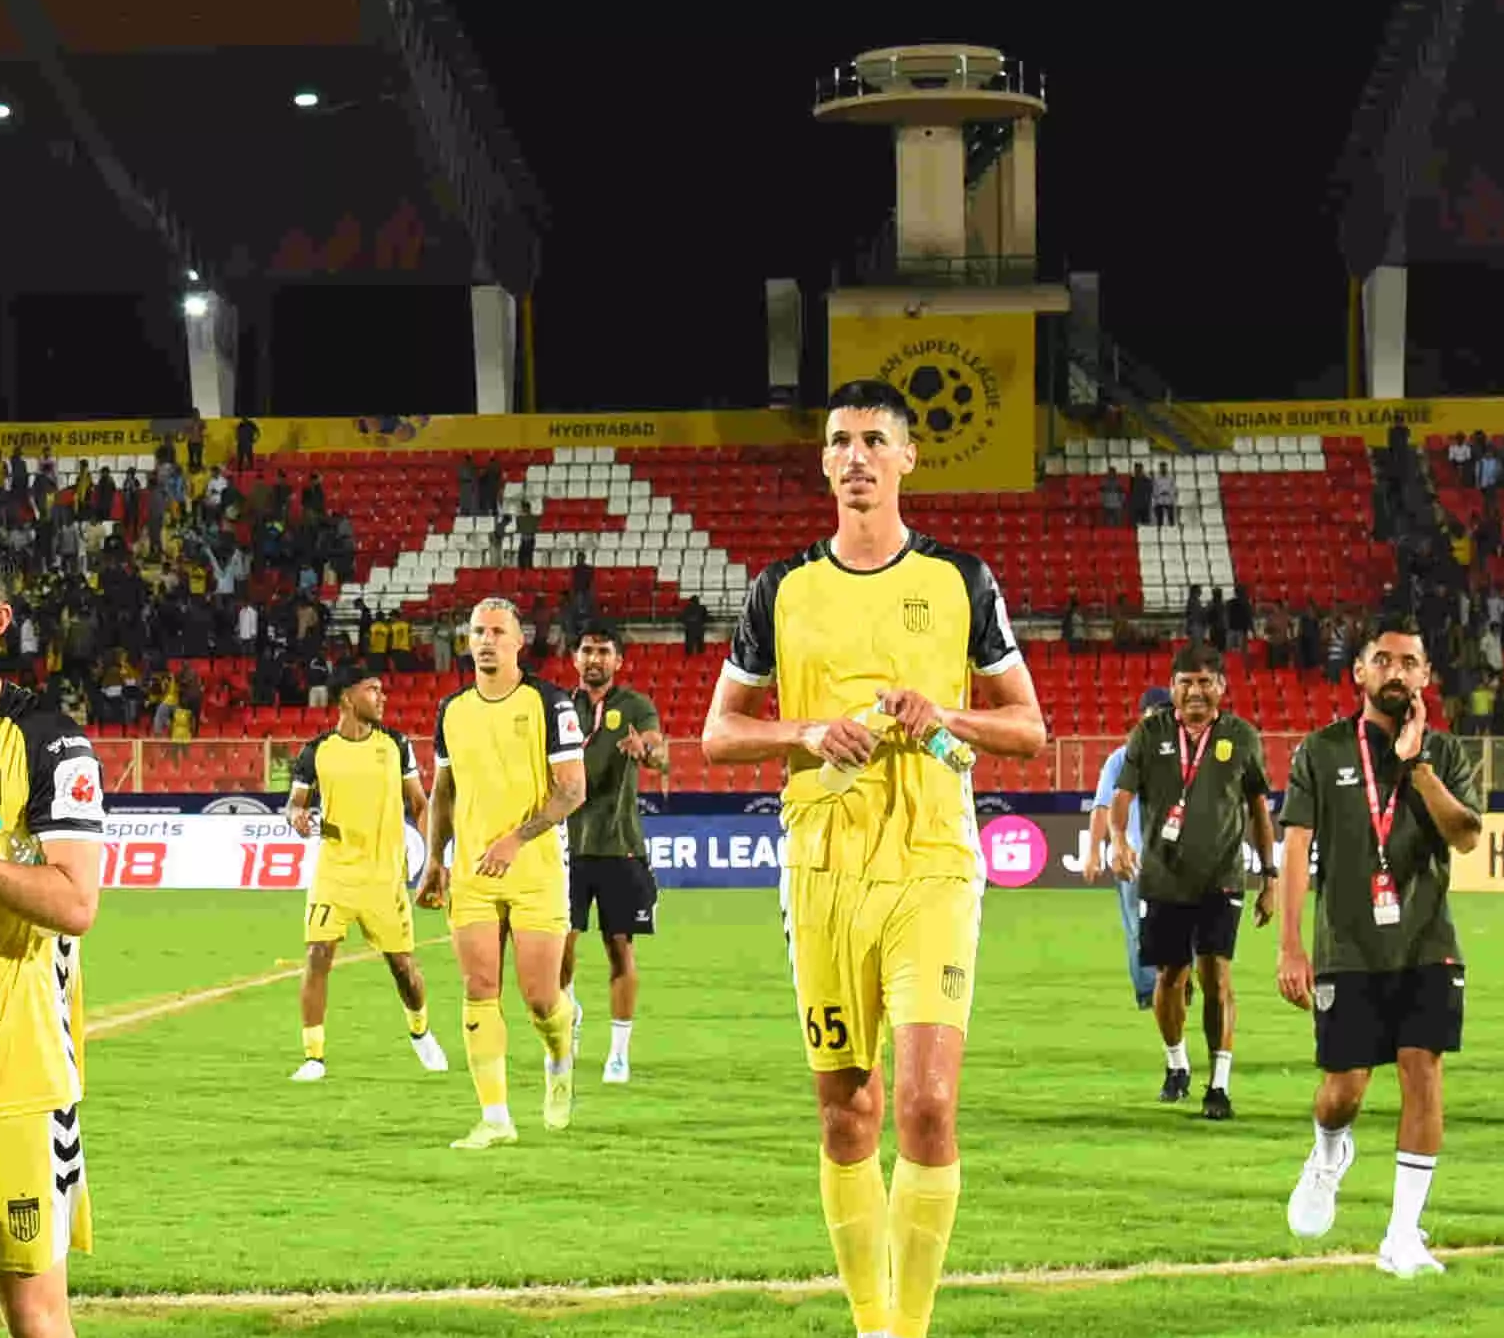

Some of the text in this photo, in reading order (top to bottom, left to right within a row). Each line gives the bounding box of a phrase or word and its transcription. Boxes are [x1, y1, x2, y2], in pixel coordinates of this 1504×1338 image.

[1215, 411, 1282, 427] INDIAN
[1286, 409, 1351, 425] SUPER
[1, 430, 64, 446] INDIAN
[68, 429, 124, 445] SUPER
[548, 423, 655, 441] HYDERABAD
[105, 821, 184, 838] sports
[103, 842, 167, 886] 18
[240, 843, 306, 886] 18
[807, 1006, 848, 1050] 65
